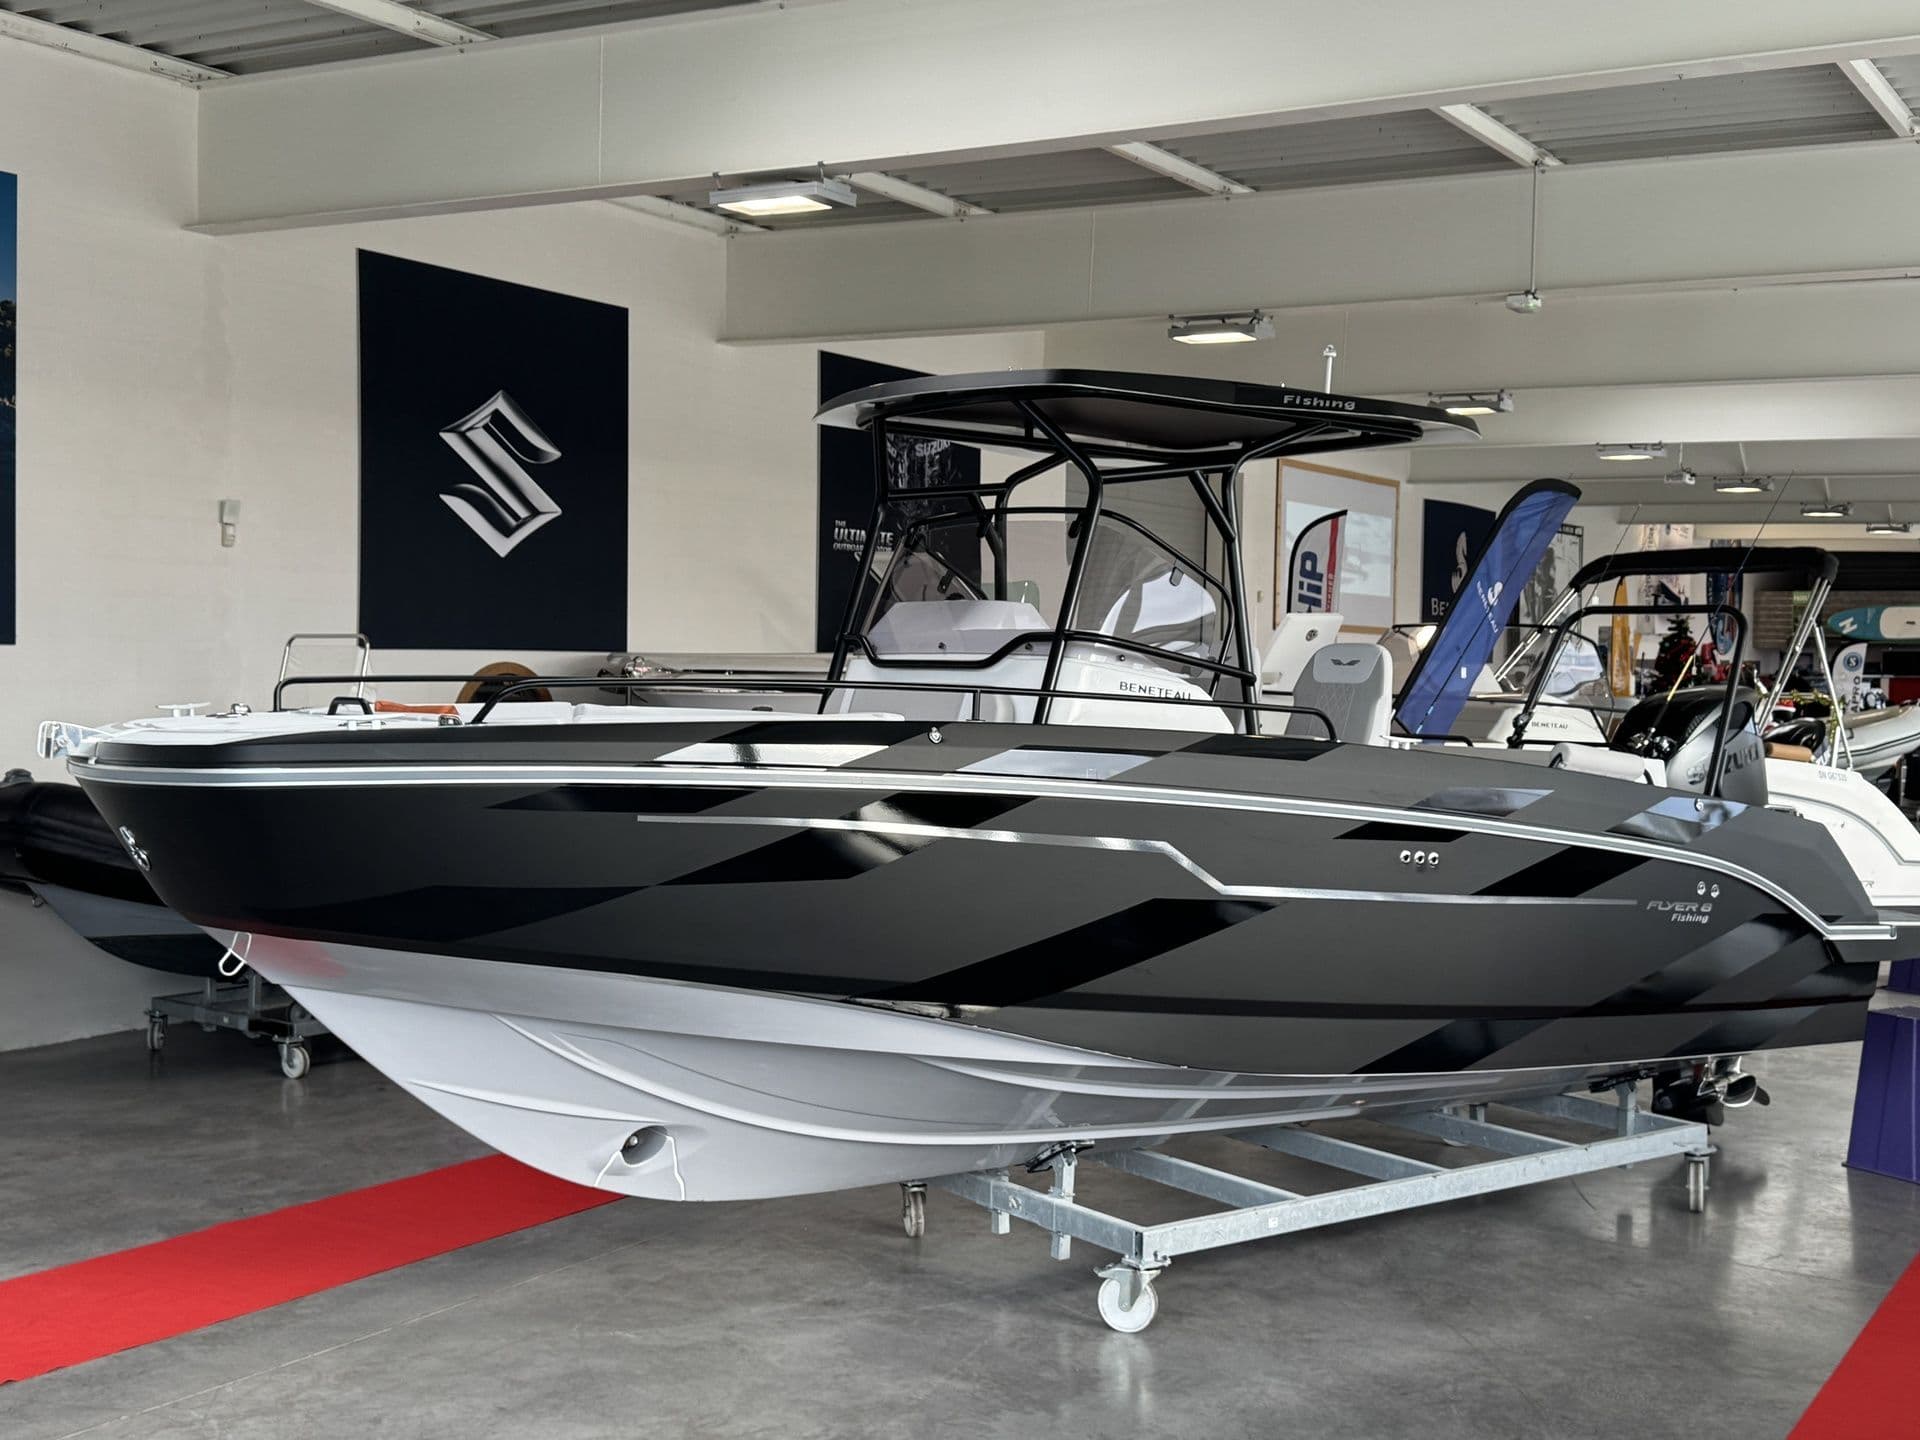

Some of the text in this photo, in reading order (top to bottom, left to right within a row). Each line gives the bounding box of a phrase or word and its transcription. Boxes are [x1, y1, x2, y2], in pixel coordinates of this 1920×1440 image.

[1283, 395, 1356, 410] Fishing
[1477, 581, 1499, 633] BENETEAU
[1120, 681, 1191, 700] BENETEAU
[1531, 721, 1568, 729] BENETEAU
[1647, 901, 1698, 911] FLYER
[1671, 913, 1709, 924] Fishing
